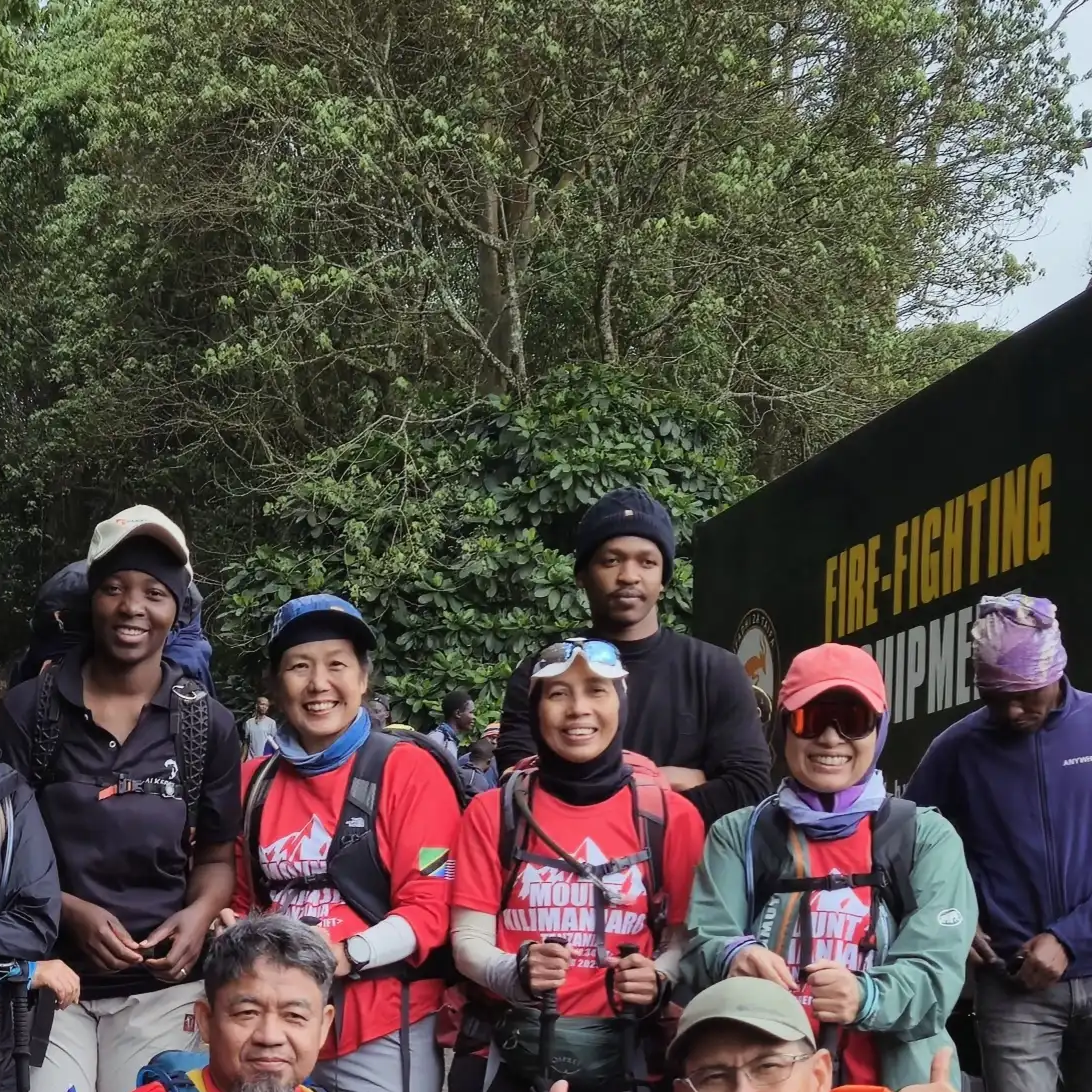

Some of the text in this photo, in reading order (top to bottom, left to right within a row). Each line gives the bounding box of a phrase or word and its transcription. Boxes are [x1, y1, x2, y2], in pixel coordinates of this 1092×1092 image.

[825, 453, 1053, 643] FIRE-FIGHTING
[861, 588, 1022, 724] UIPME
[503, 907, 646, 936] KILIMANARO
